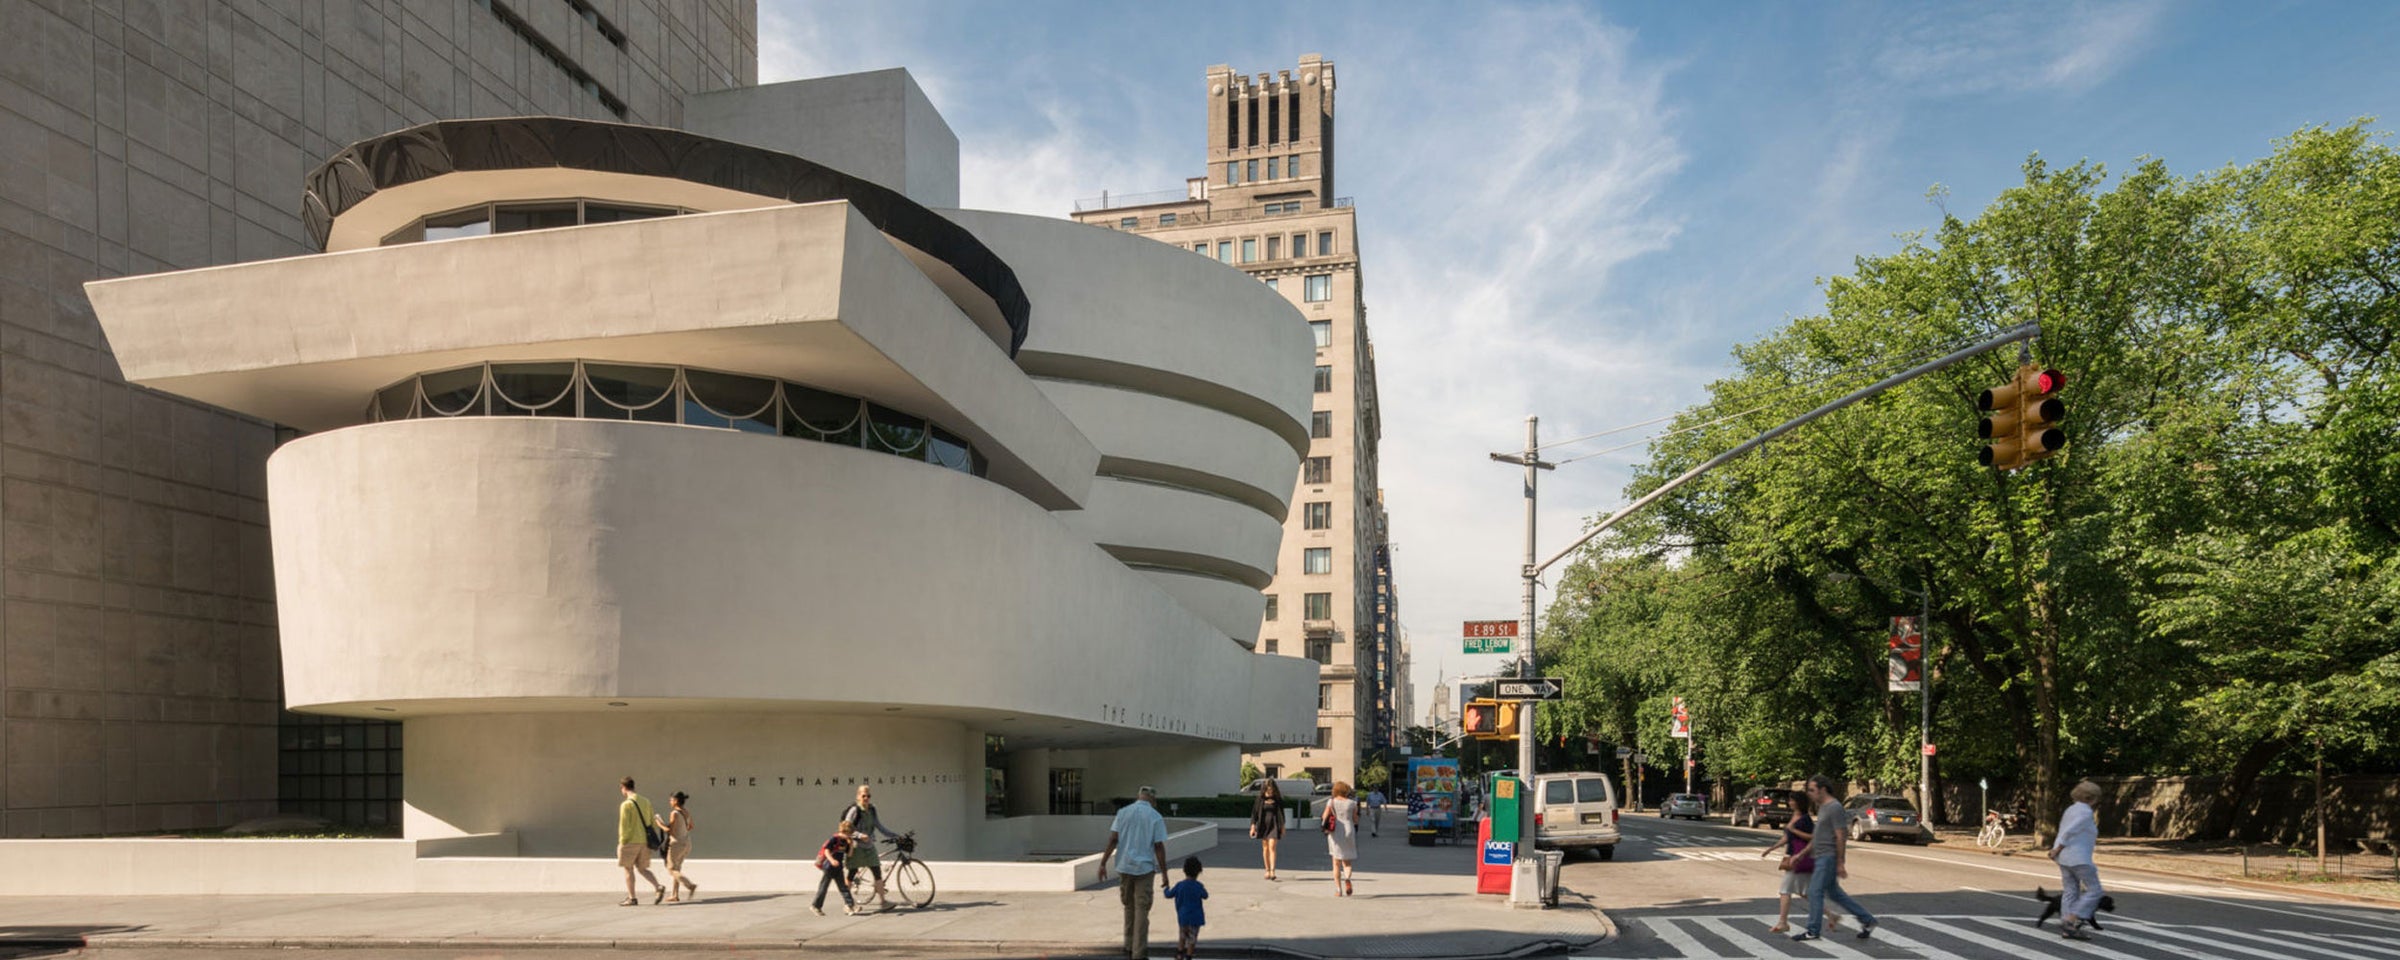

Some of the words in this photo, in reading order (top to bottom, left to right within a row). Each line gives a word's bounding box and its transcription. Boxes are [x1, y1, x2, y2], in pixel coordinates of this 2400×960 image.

[1474, 624, 1480, 636] E
[1483, 624, 1495, 636] 89
[1498, 624, 1508, 636] St
[1464, 639, 1482, 648] FRED
[1504, 685, 1524, 694] ONE
[1533, 684, 1553, 694] WAY
[1103, 704, 1126, 724] THE
[709, 776, 756, 787] THE
[1486, 841, 1511, 850] VOICE
